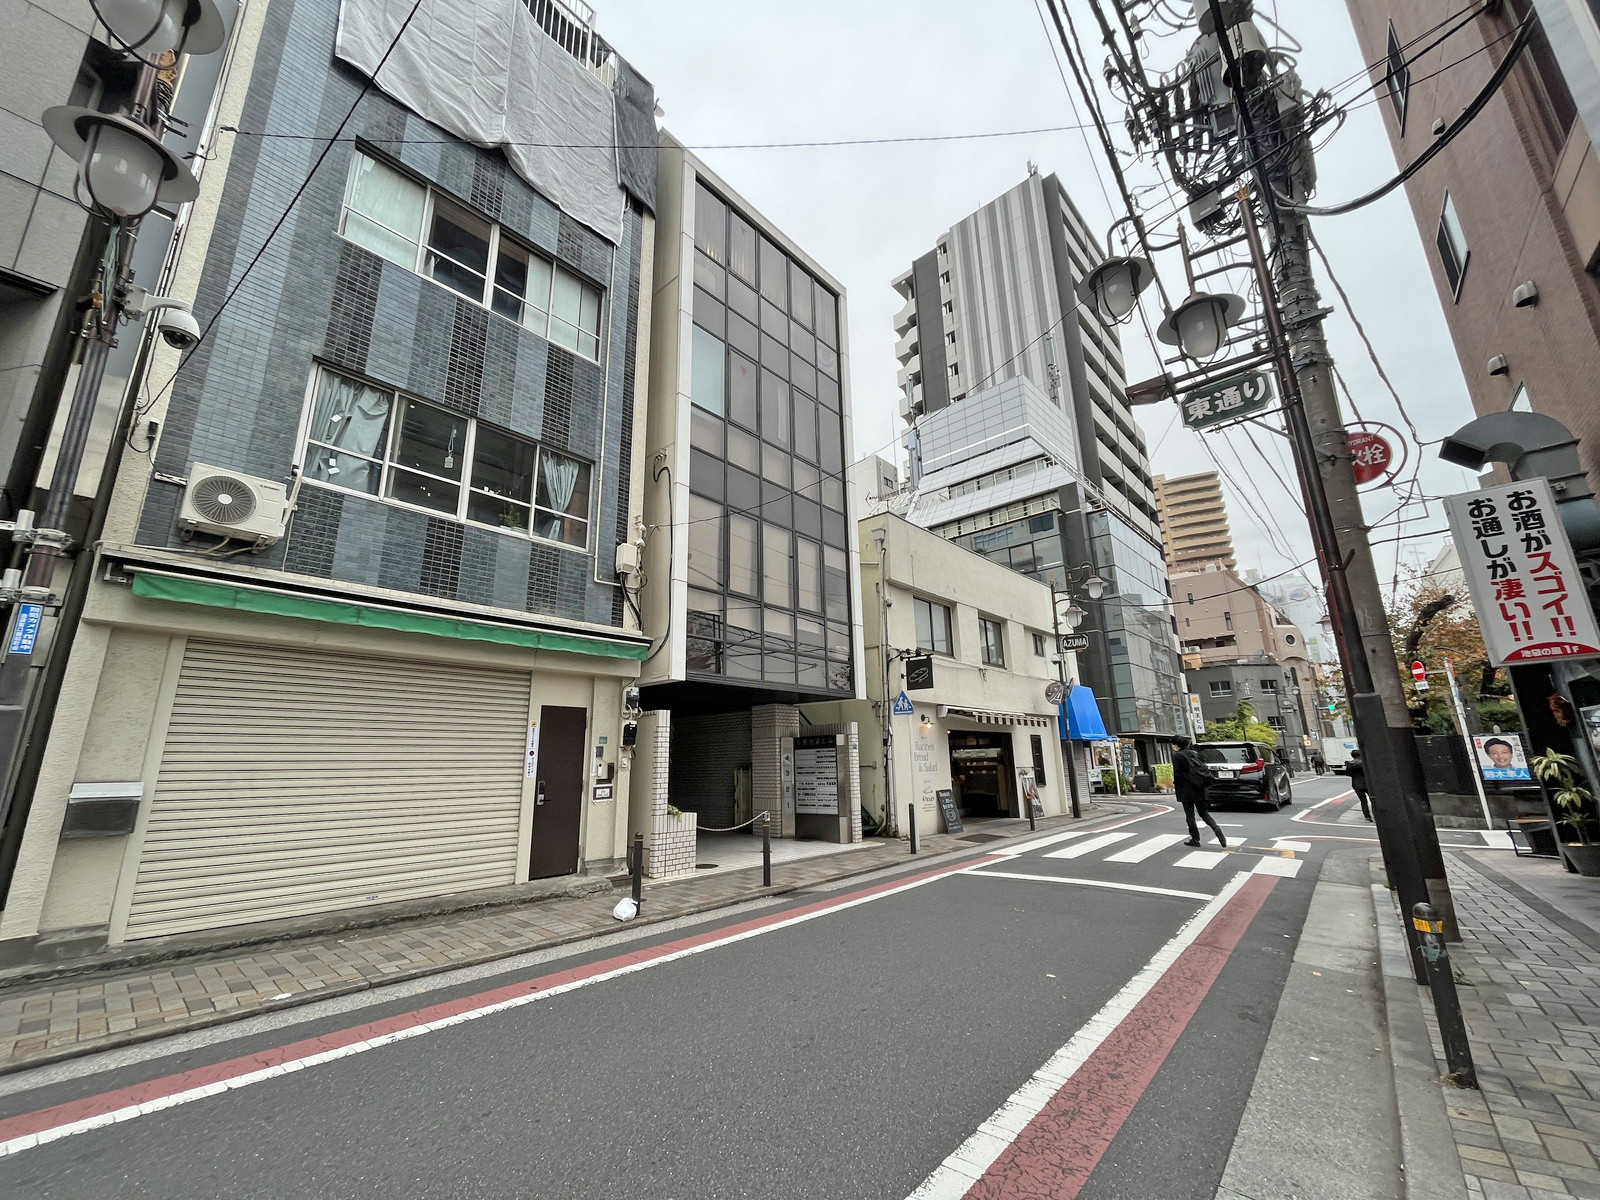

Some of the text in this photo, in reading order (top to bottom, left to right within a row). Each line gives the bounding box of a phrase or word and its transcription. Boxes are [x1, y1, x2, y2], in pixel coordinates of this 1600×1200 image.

[1185, 376, 1266, 423] 東通り
[1349, 436, 1374, 446] YDRANT
[1351, 443, 1387, 467] 火栓
[1467, 497, 1535, 642] お通しが凄い!!
[1506, 490, 1577, 638] お酒がスゴイ!!
[1063, 637, 1087, 648] AZUMA
[914, 741, 936, 752] Racines
[913, 751, 929, 762] Bread
[923, 761, 938, 772] Salad
